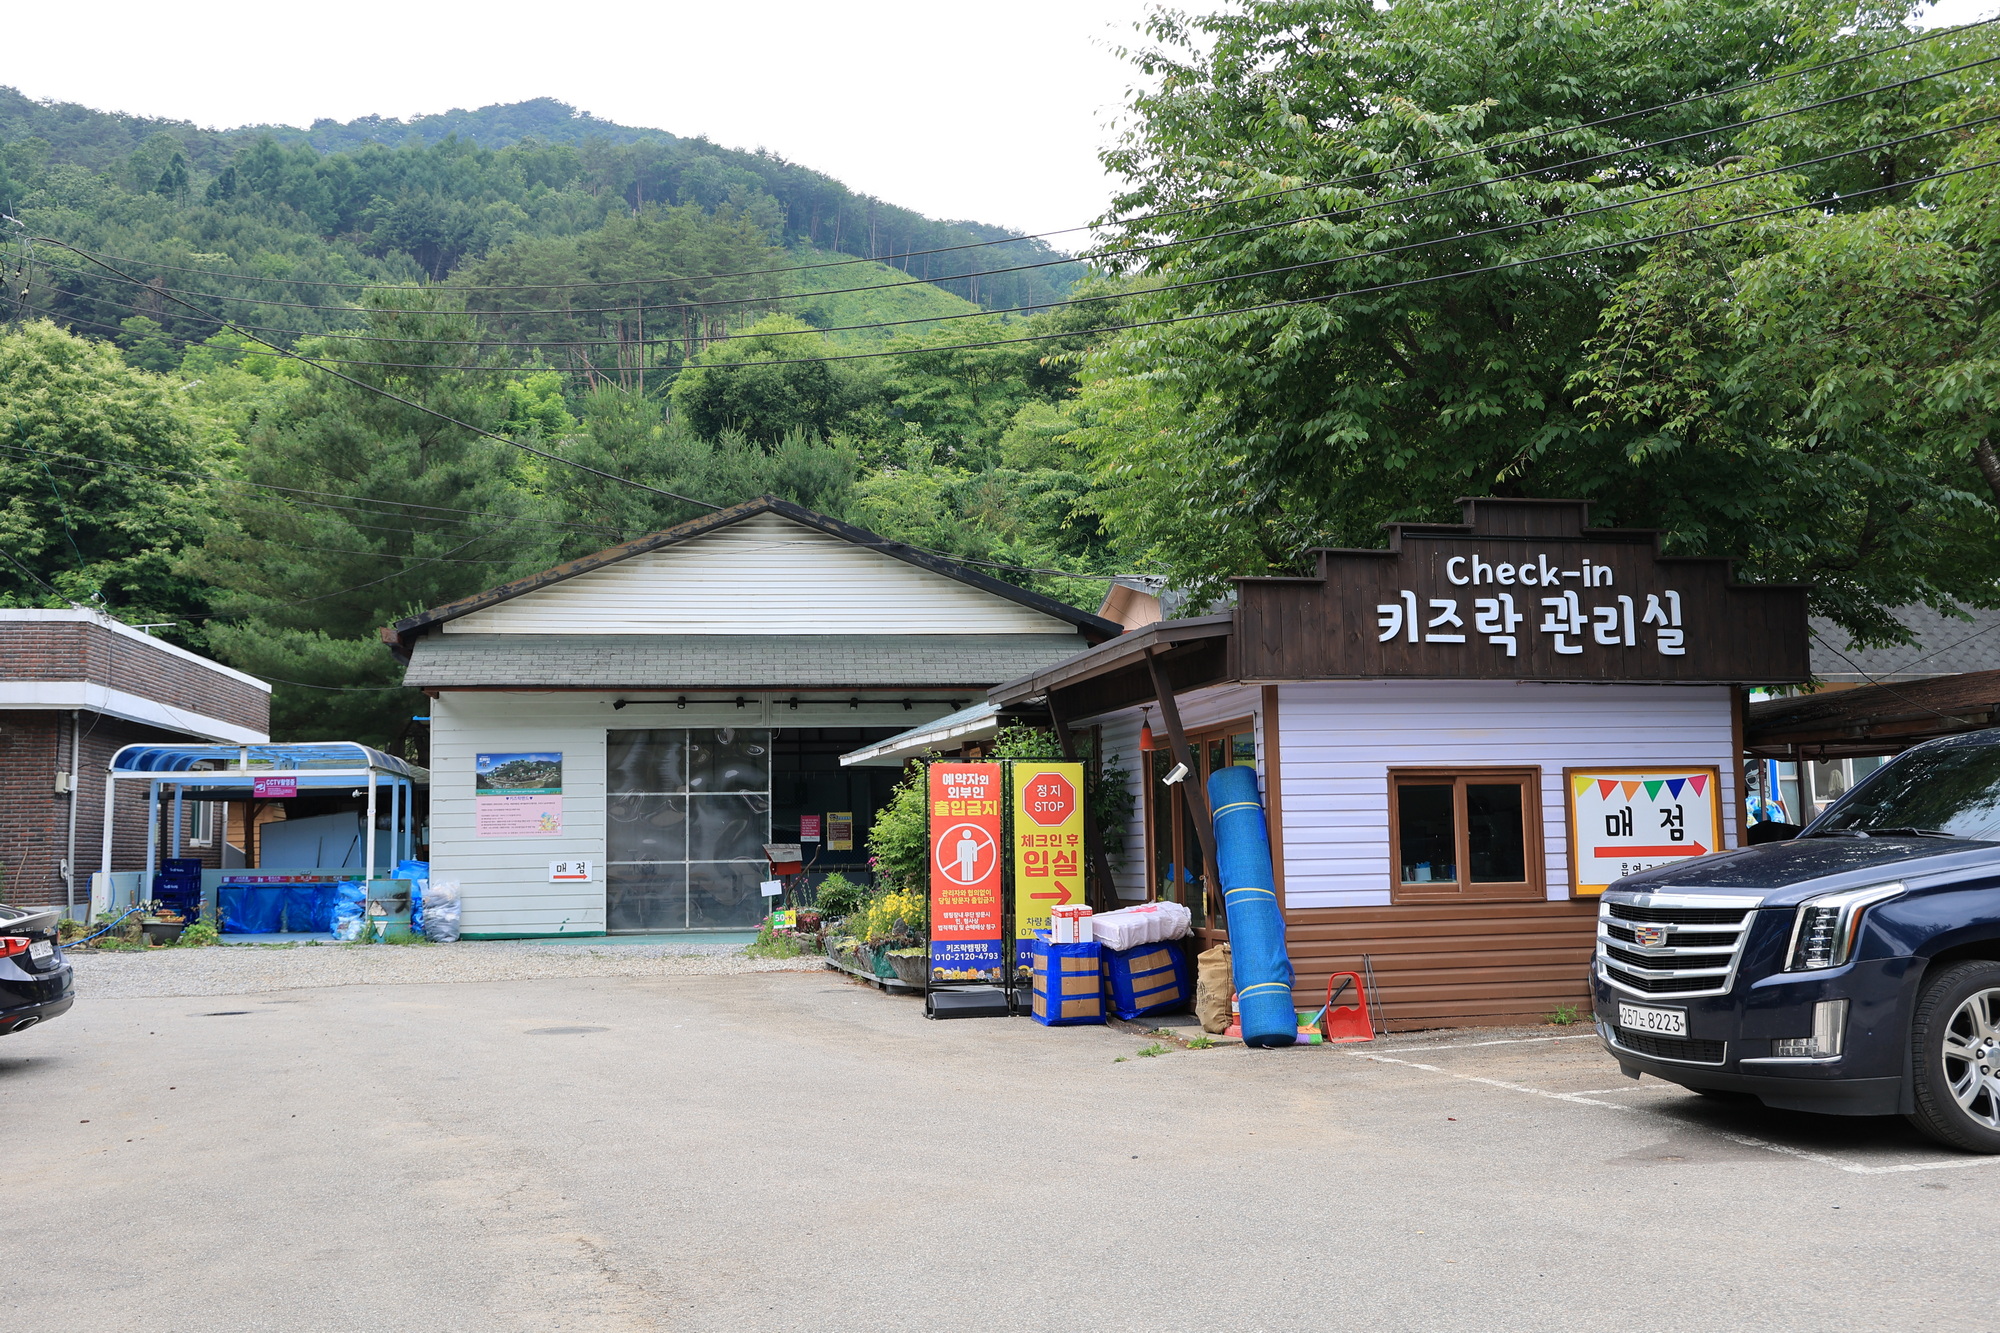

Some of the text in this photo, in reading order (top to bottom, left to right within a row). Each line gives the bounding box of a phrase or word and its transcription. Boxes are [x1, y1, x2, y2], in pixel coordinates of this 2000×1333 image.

[1446, 553, 1614, 588] Check-in
[1376, 590, 1686, 657] 키즈락 관리실
[942, 773, 989, 786] 예약자외
[947, 786, 985, 799] 외부인
[934, 800, 998, 817] 출입금지
[1034, 801, 1065, 813] STOP
[1021, 834, 1079, 848] 체크인 후
[1023, 850, 1078, 877] 입실
[942, 889, 992, 897] 관리자와 협의없이
[938, 897, 995, 905] 당일 방문자 출입금지
[964, 911, 975, 919] 무단
[1026, 916, 1043, 926] 차량
[946, 943, 988, 953] 키즈락캠핑장
[935, 952, 999, 961] 010-2120-4793
